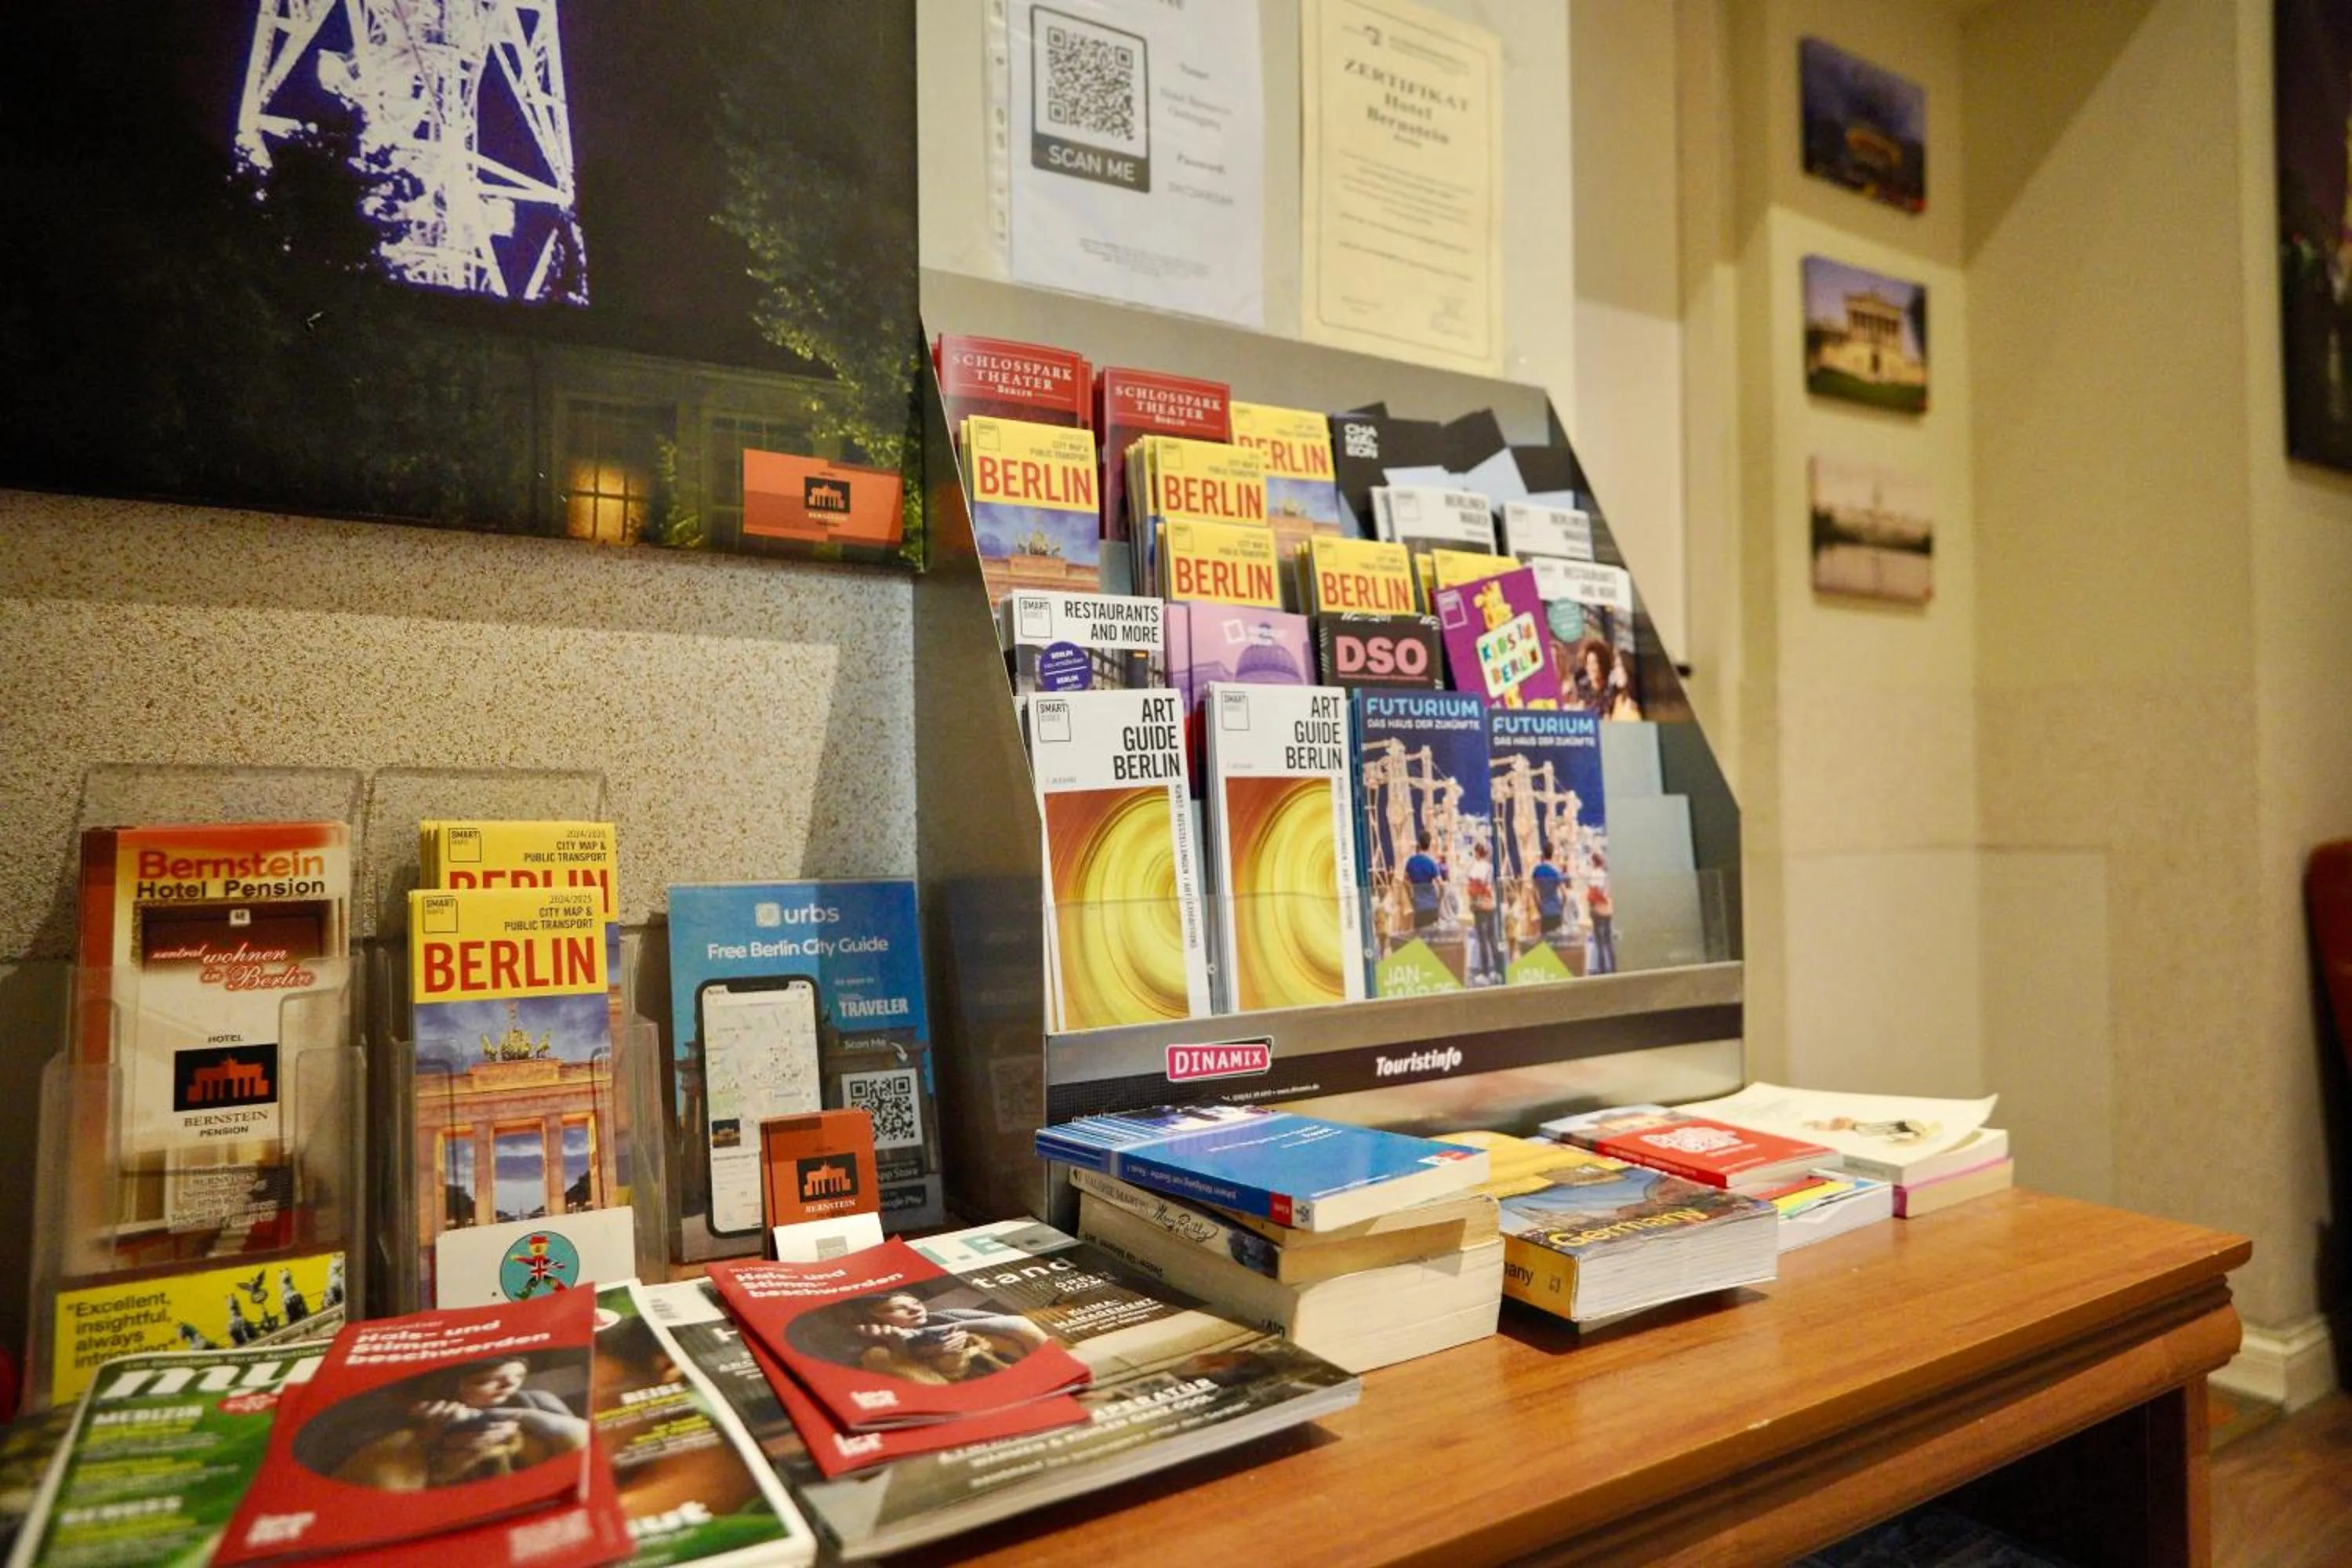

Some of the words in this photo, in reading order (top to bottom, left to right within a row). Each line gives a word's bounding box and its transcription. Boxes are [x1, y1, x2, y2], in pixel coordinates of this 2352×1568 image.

[1048, 145, 1102, 175] SCAN
[1106, 159, 1135, 182] ME
[952, 354, 1073, 381] SCHLOSSPARK
[975, 369, 1053, 390] THEATER
[1115, 386, 1221, 411] SCHLOSSPARK
[1135, 401, 1203, 420] THEATER
[978, 456, 1092, 505] BERLIN
[1163, 474, 1262, 520] BERLIN
[1174, 556, 1273, 601] BERLIN
[1322, 572, 1410, 611] BERLIN
[1065, 601, 1160, 622] RESTAURANTS
[1091, 623, 1117, 641] AND
[1122, 626, 1159, 643] MORE
[1335, 635, 1428, 675] DSO
[1040, 703, 1066, 714] SMART
[1142, 698, 1175, 723] ART
[1312, 696, 1339, 718] ART
[1367, 698, 1479, 717] FUTURIUM
[1294, 720, 1341, 744] GUIDE
[1367, 718, 1385, 728] DAS
[1388, 719, 1413, 728] HAUS
[1415, 719, 1433, 729] DER
[1493, 717, 1594, 734] FUTURIUM
[1123, 726, 1178, 752] GUIDE
[1113, 753, 1181, 780] BERLIN
[1286, 746, 1342, 770] BERLIN
[451, 830, 480, 839] SMART
[524, 852, 555, 862] PUBLIC
[557, 852, 607, 862] TRANSPORT
[556, 841, 575, 851] CITY
[579, 841, 597, 851] MAP
[600, 841, 606, 850] &
[139, 851, 324, 879] Bernstein
[137, 880, 206, 898] Hotel
[223, 878, 325, 898] Pension
[426, 898, 455, 907] SMART
[539, 908, 560, 917] CITY
[564, 906, 583, 916] MAP
[586, 907, 593, 916] &
[784, 903, 840, 924] urbs
[504, 921, 538, 931] PUBLIC
[540, 919, 593, 930] TRANSPORT
[203, 942, 288, 964] wohnen
[708, 943, 746, 960] Free
[750, 941, 800, 957] Berlin
[803, 938, 836, 958] City
[840, 936, 888, 953] Guide
[424, 937, 597, 993] BERLIN
[227, 964, 314, 990] Berlin
[839, 998, 909, 1018] TRAVELER
[208, 1034, 244, 1044] HOTEL
[1175, 1051, 1262, 1074] DINAMIX
[1376, 1047, 1462, 1076] Touristinfo
[183, 1110, 268, 1127] BERNSTEIN
[199, 1125, 249, 1138] PENSION
[1548, 1208, 1709, 1247] Germany
[749, 1272, 904, 1298] beschwerden
[802, 1269, 847, 1280] und
[1504, 1261, 1534, 1287] any
[75, 1330, 144, 1352] always
[356, 1330, 439, 1344] Hals-
[445, 1319, 501, 1337] und
[346, 1332, 551, 1365] beschwerden
[352, 1338, 465, 1354] Stimm-
